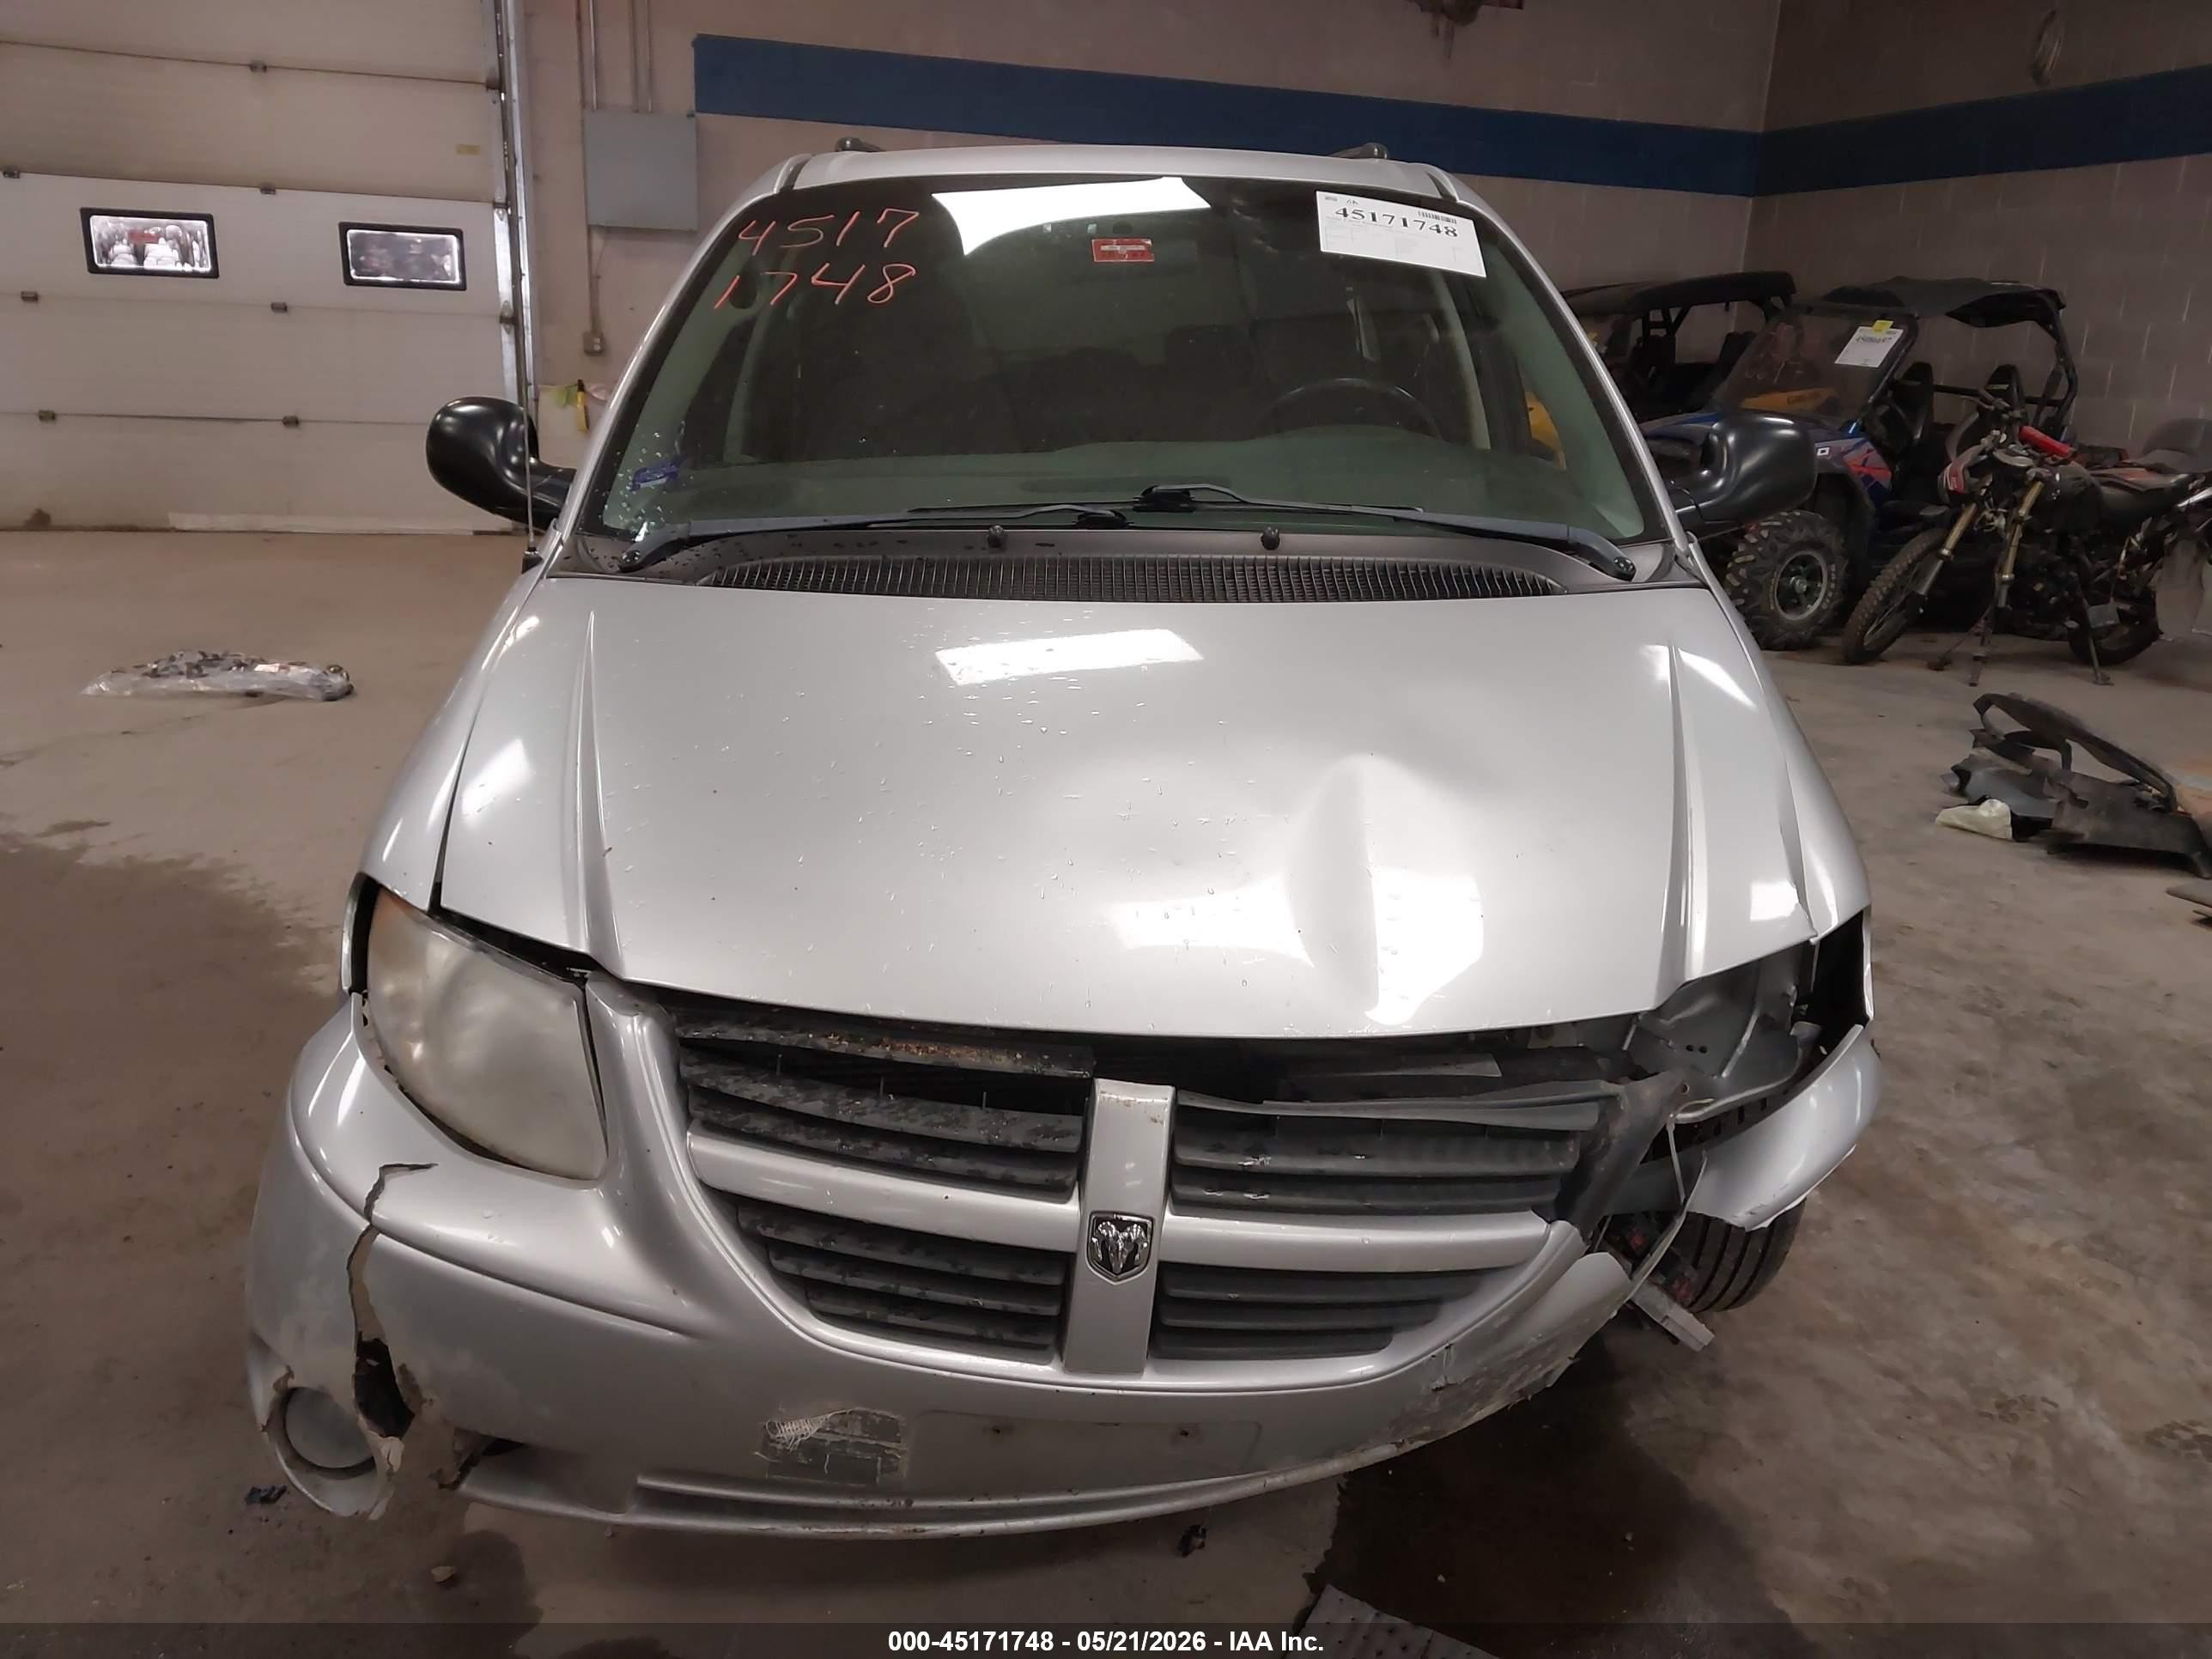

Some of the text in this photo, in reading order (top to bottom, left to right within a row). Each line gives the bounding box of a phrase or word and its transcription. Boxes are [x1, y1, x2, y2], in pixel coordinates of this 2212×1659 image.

[738, 208, 920, 256] 4517
[1335, 207, 1458, 237] 45171748
[714, 262, 916, 309] 1748
